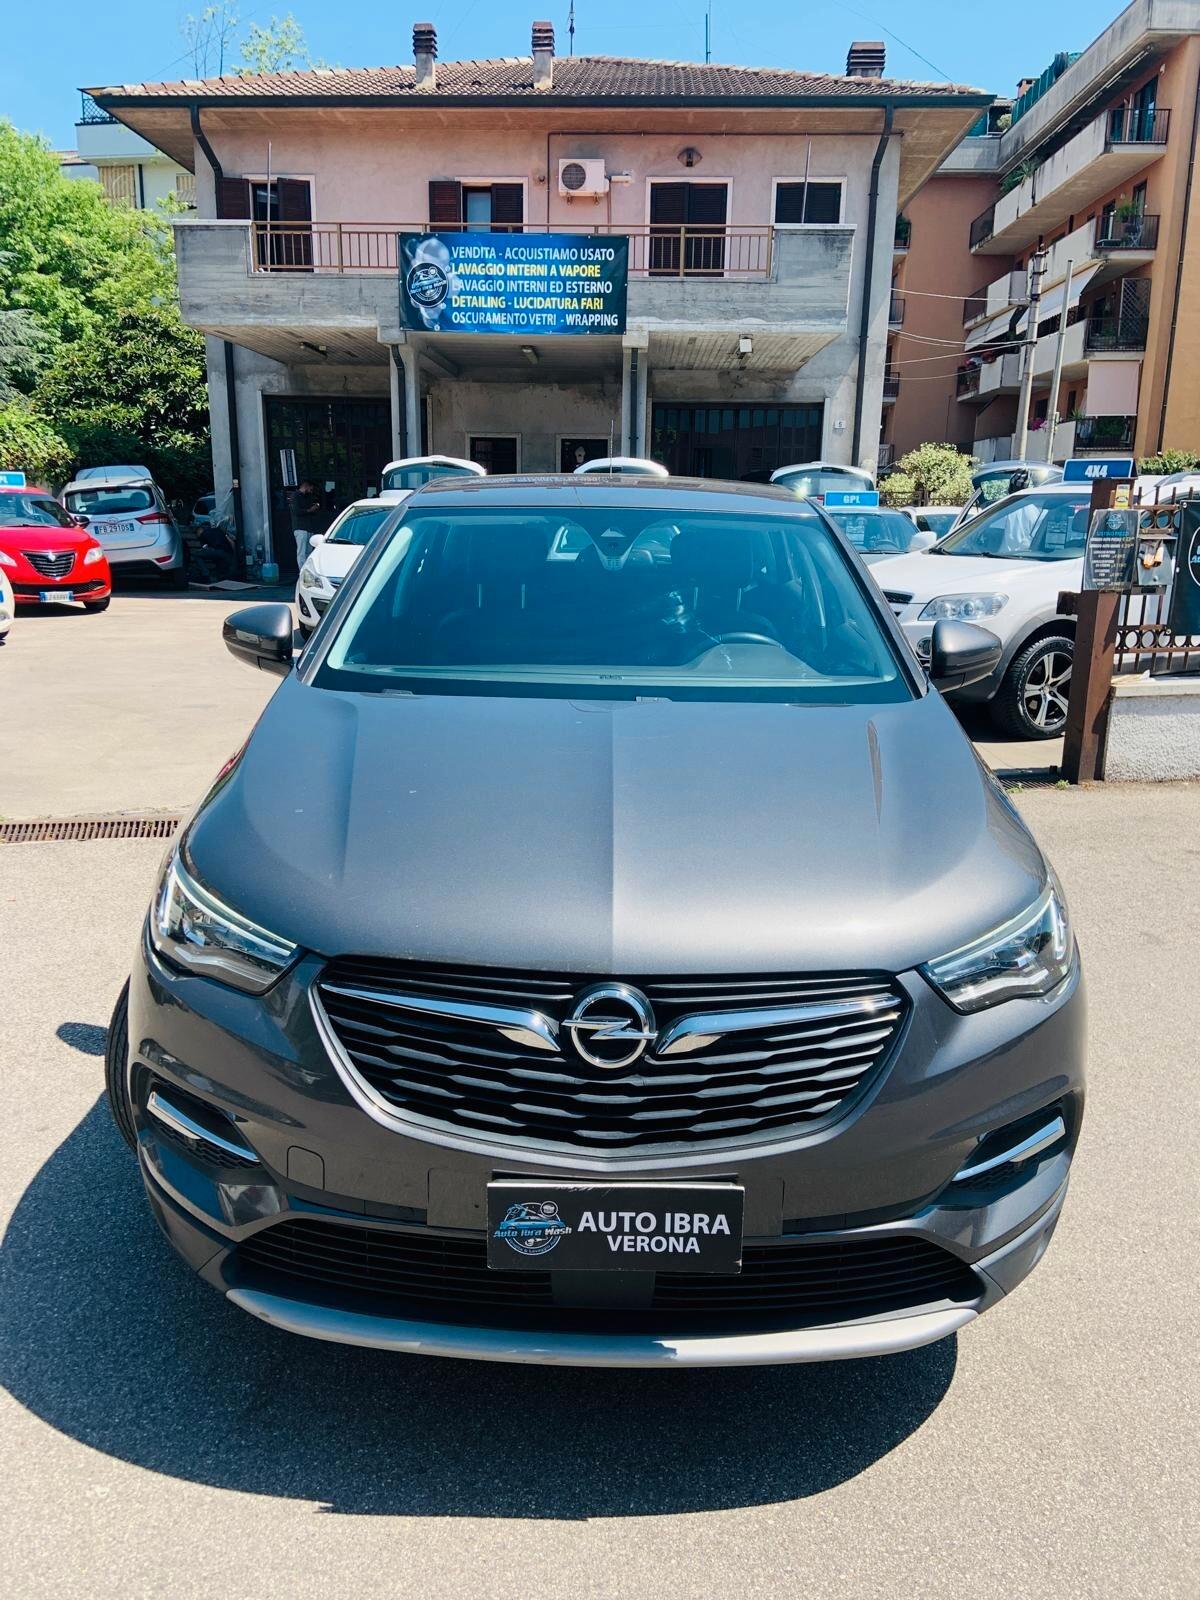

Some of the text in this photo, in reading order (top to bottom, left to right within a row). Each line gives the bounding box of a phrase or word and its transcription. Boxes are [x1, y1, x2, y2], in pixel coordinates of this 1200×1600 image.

[451, 246, 497, 260] VENDITA
[504, 247, 578, 261] ACQUISTIAMO
[580, 248, 615, 262] USATO
[451, 263, 601, 277] LAVAGGIO INTERNI A VAPORE
[451, 279, 504, 292] LAVAGGIO
[506, 280, 548, 293] INTERNI
[550, 280, 564, 293] ED
[566, 281, 613, 294] ESTERNO
[452, 295, 506, 308] DETAILING
[514, 296, 579, 310] LUCIDATURA
[580, 297, 604, 310] FARI
[452, 311, 527, 325] OSCURAMENTO
[529, 313, 557, 326] VETRI
[566, 313, 619, 327] WRAPPING
[1084, 464, 1109, 478] 4X4
[843, 494, 861, 504] GPL
[577, 1211, 731, 1235] AUTO IBRA
[493, 1228, 519, 1238] Auto
[544, 1225, 573, 1236] Wash
[606, 1235, 701, 1254] VERONA
